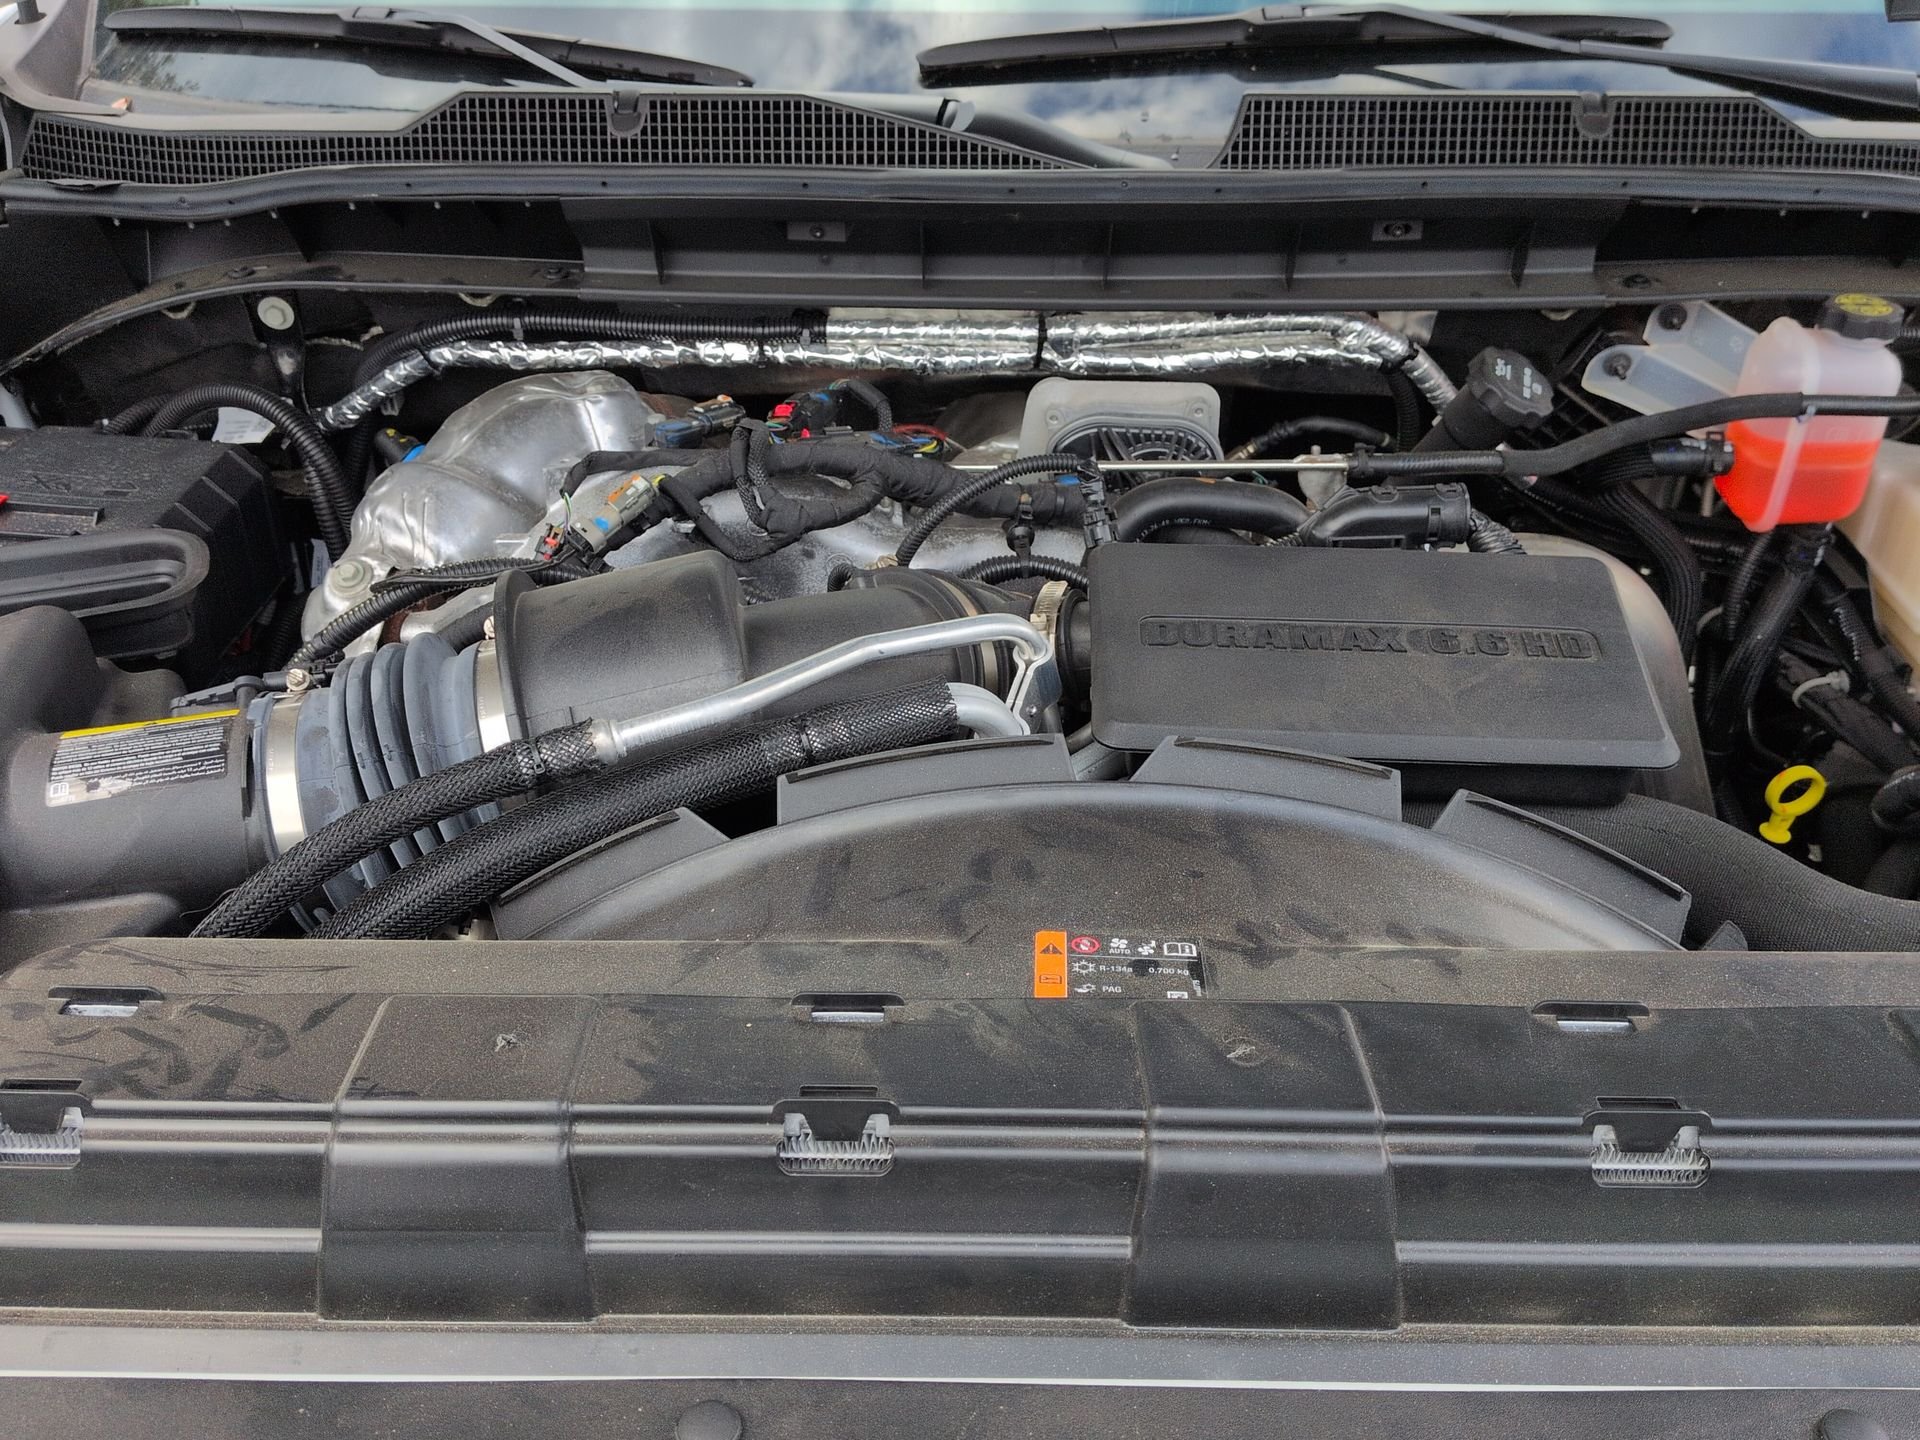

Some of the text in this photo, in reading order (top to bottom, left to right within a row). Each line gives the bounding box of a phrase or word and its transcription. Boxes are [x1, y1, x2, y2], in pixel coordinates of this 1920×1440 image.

[1146, 620, 1594, 659] DURAMAX 6.6 HD
[1099, 965, 1133, 973] R-134a
[1148, 967, 1174, 975] 0.700
[1102, 985, 1122, 993] PAG
